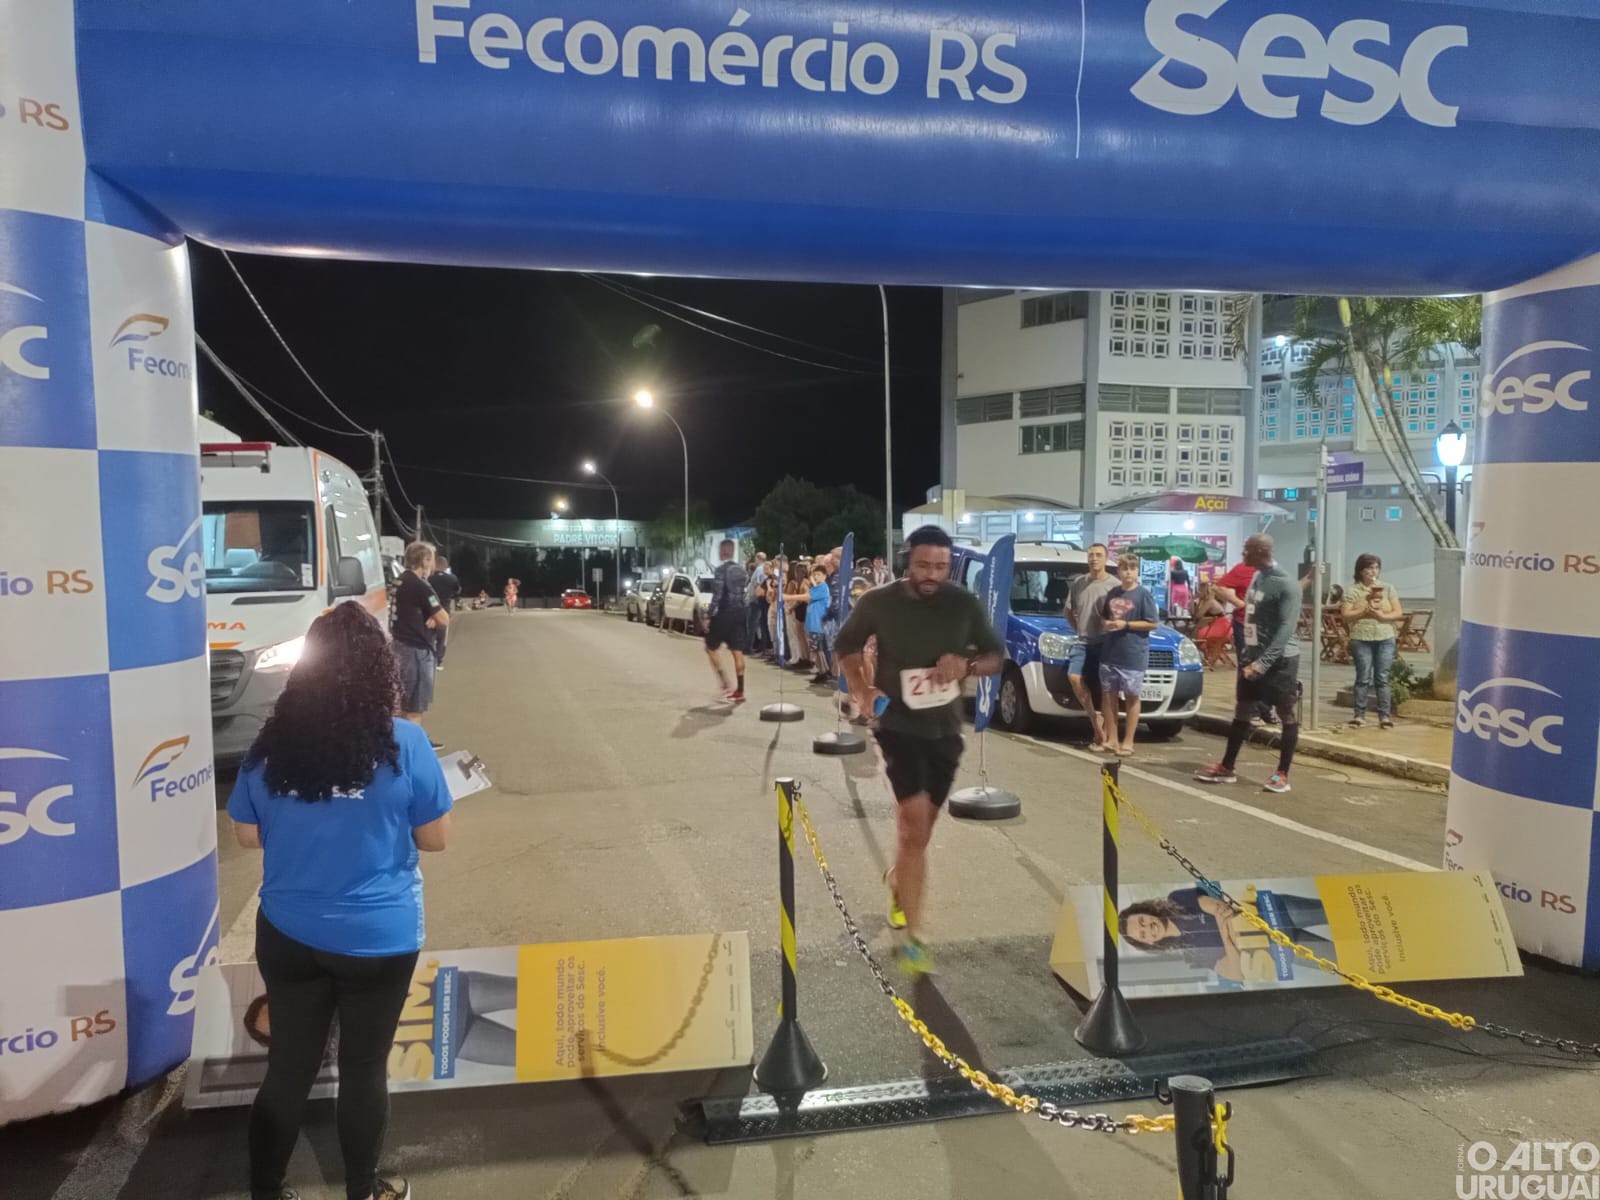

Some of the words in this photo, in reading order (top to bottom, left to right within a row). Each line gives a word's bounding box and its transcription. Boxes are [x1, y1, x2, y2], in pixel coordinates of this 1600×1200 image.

[415, 0, 899, 95] Fecomércio
[926, 28, 1028, 104] RS
[1130, 0, 1469, 127] Sesc
[19, 97, 69, 131] RS
[1563, 554, 1600, 575] RS
[47, 569, 94, 595] RS
[1456, 690, 1564, 755] Sesc
[1347, 886, 1364, 919] mundo
[1541, 890, 1577, 914] RS
[1358, 921, 1371, 945] todo
[1360, 897, 1381, 946] aproveitar
[566, 956, 576, 970] os
[554, 959, 565, 1000] mundo
[555, 1002, 565, 1033] todo
[565, 972, 576, 1034] aproveitar
[575, 993, 585, 1010] do
[70, 1009, 116, 1042] RS
[441, 1013, 450, 1044] PODEM
[440, 1044, 449, 1076] TODOS
[565, 1037, 576, 1069] pode
